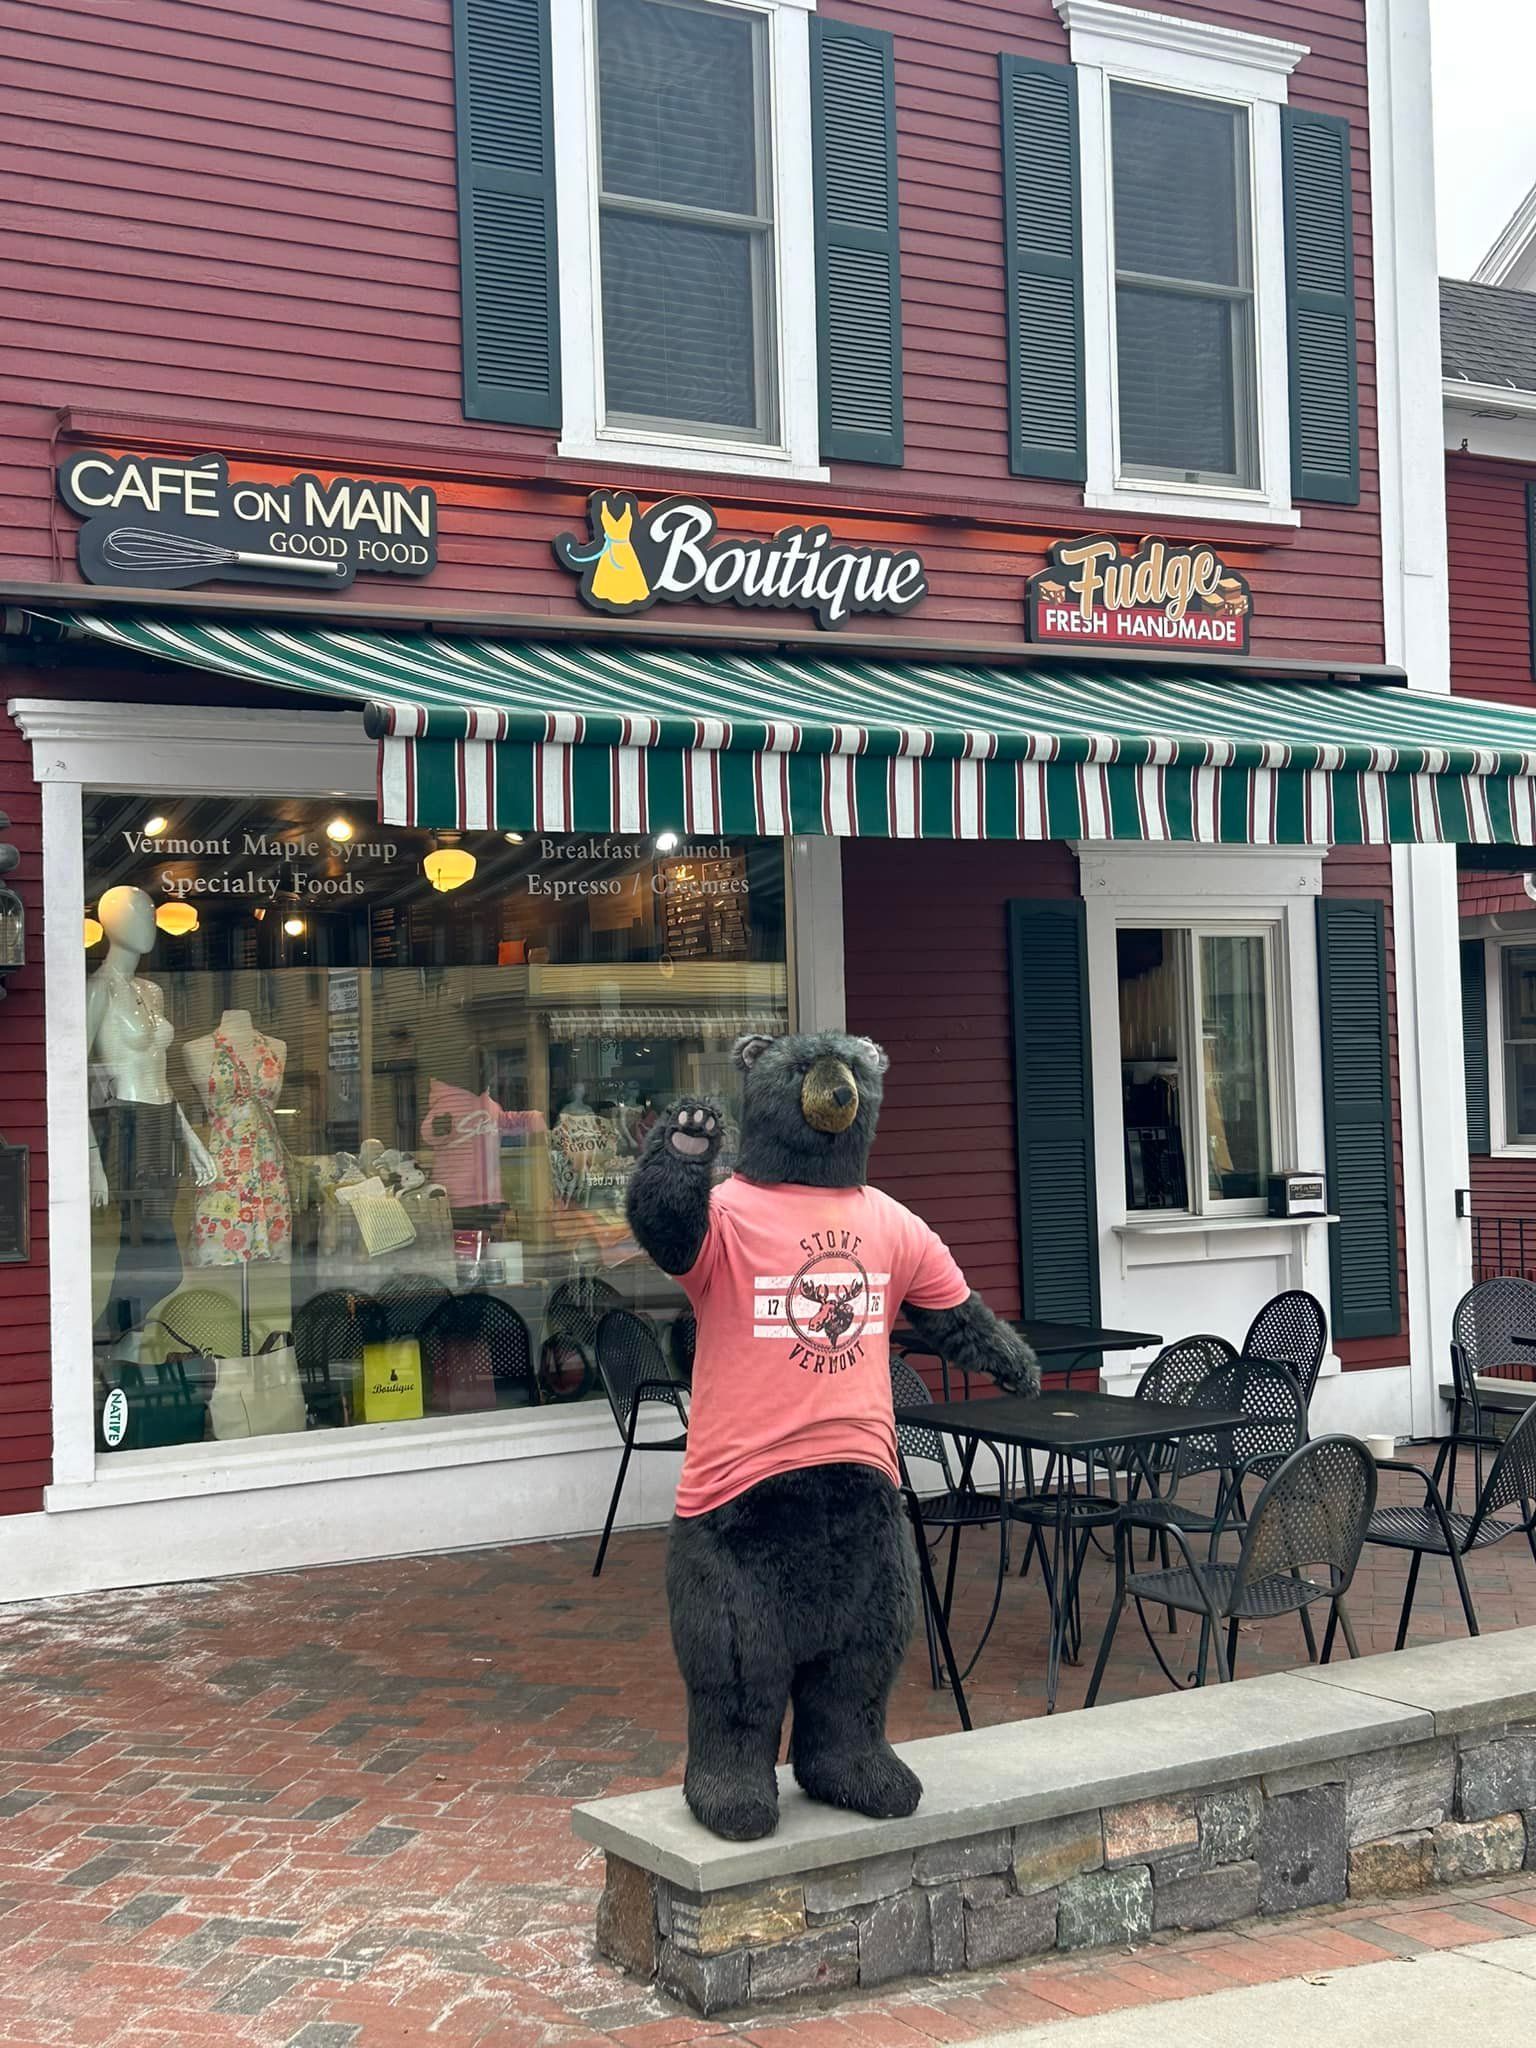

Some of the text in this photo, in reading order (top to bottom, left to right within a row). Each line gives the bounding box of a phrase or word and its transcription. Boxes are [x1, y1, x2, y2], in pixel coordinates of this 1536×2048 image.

[70, 460, 431, 538] CAFÉ ON MAIN
[269, 532, 430, 566] GOOD FOOD
[650, 504, 925, 621] Boutique
[1060, 541, 1222, 622] Fudge
[1045, 608, 1237, 642] FRESH HANDMADE
[122, 831, 398, 865] Vermont Maple Syrup
[540, 838, 641, 860] Breakfast
[160, 869, 365, 899] Specialty Foods
[527, 874, 622, 901] Espresso
[800, 1230, 862, 1258] STOWE
[767, 1299, 780, 1316] 17
[789, 1340, 865, 1374] VERMONT
[108, 1393, 122, 1441] NATIVE
